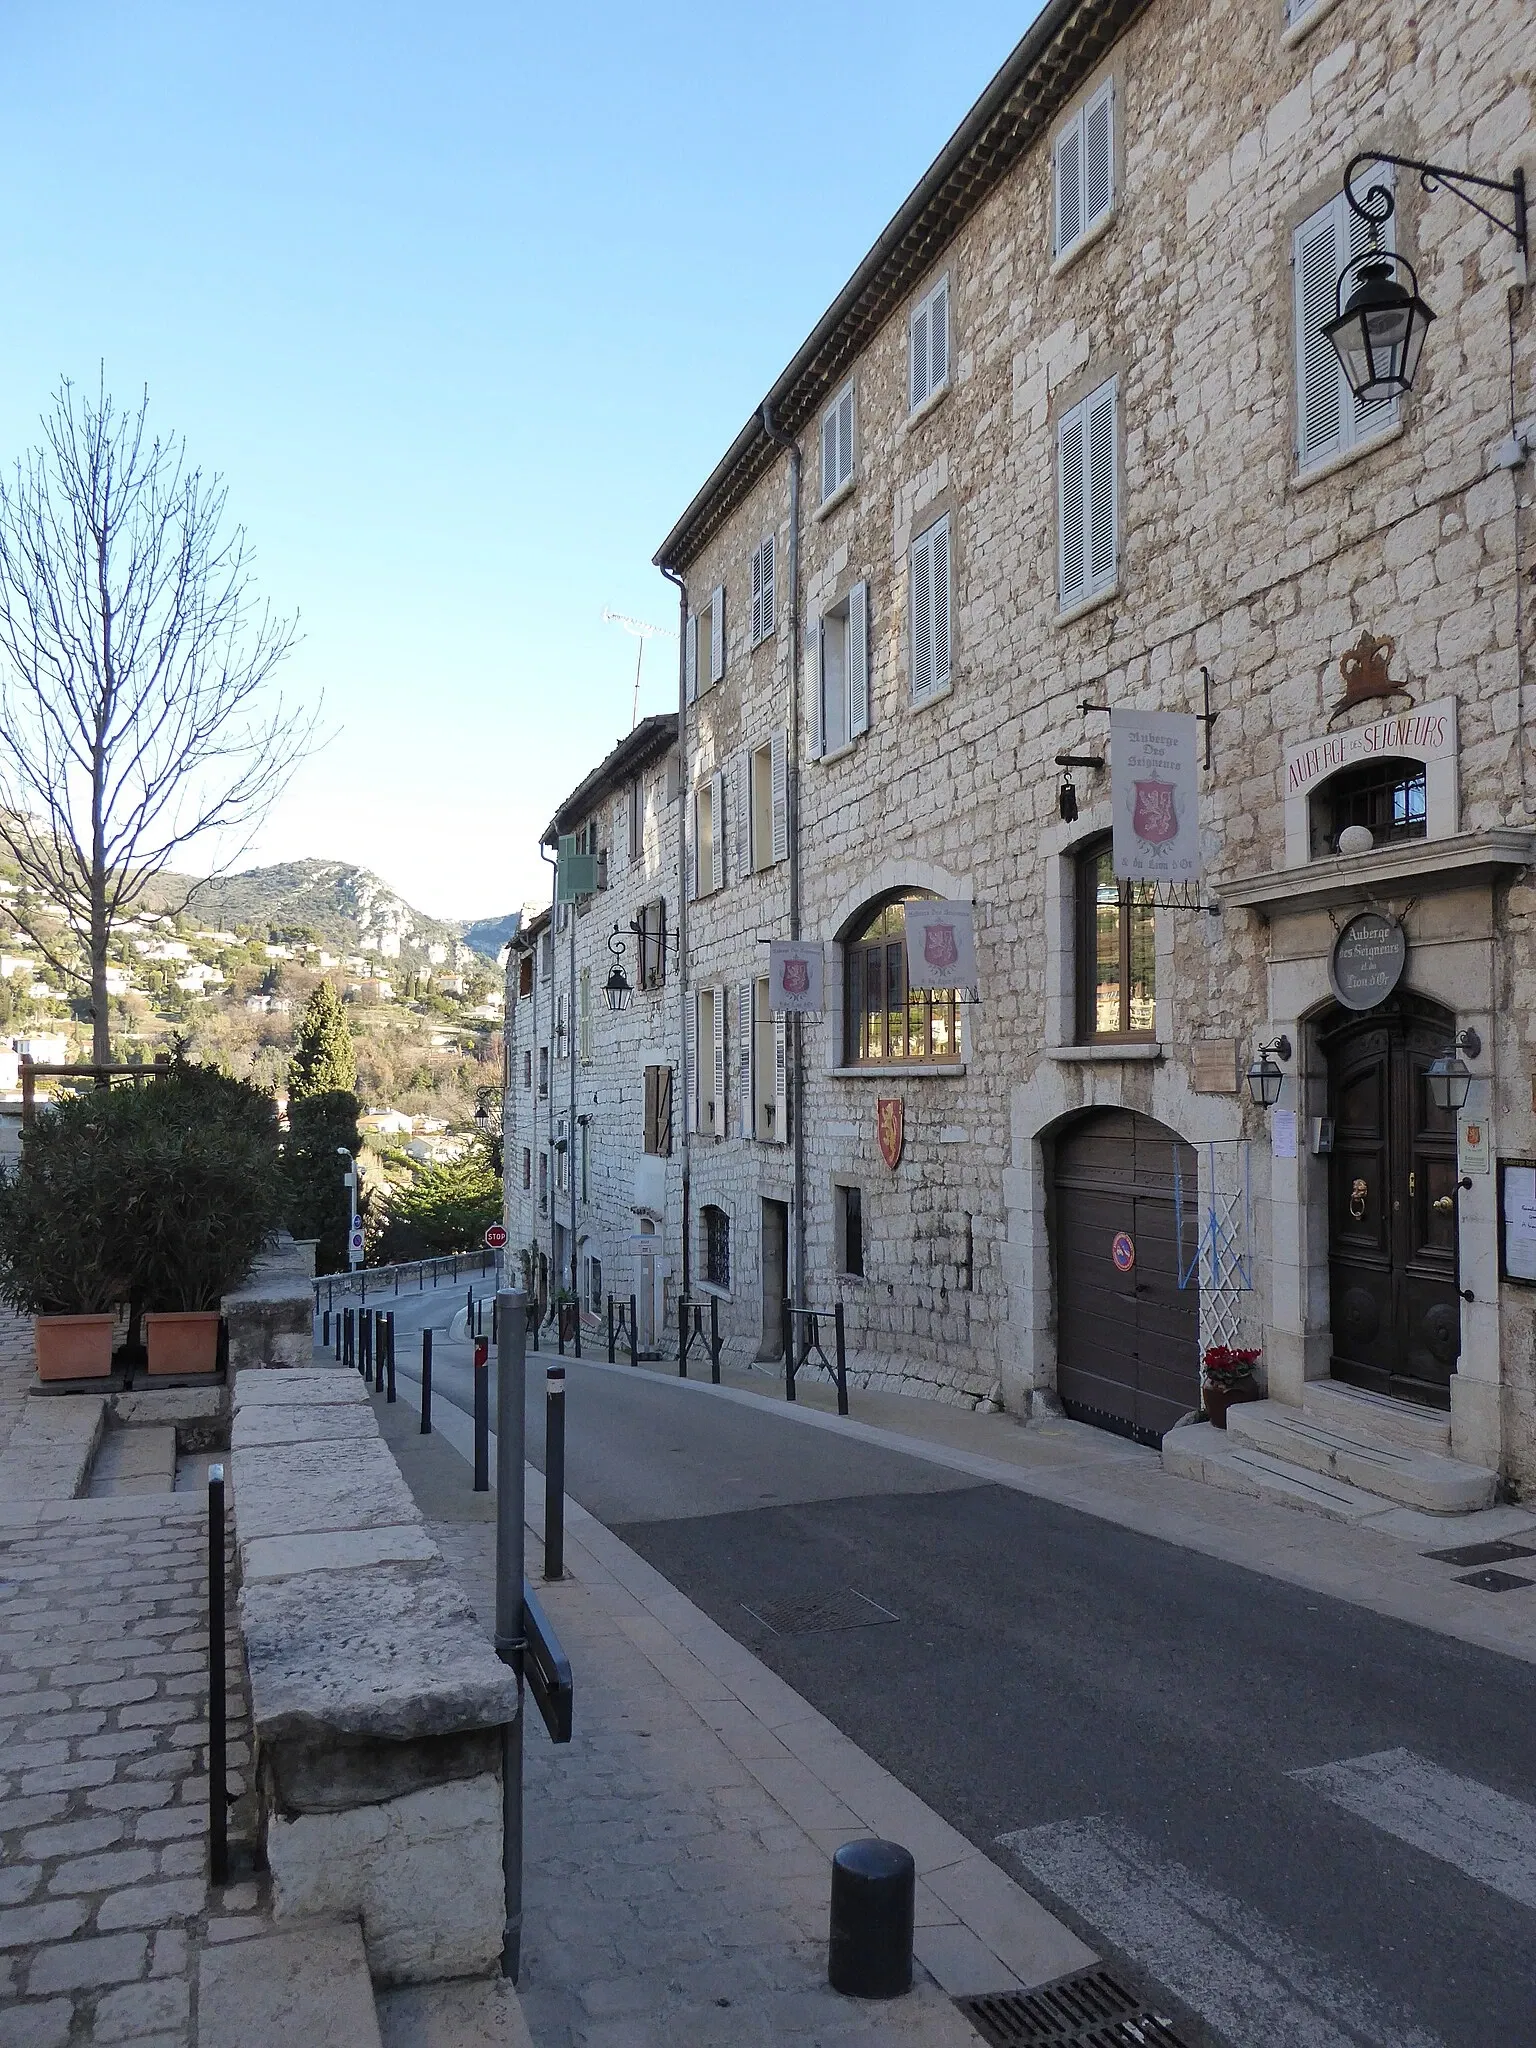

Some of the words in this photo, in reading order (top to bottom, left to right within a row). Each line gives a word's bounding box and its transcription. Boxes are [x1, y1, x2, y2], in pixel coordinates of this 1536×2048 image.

[1128, 731, 1180, 747] Auberge
[1143, 743, 1166, 757] Des
[1289, 736, 1348, 793] AUBERGE
[1363, 716, 1448, 753] SEIGNEURS
[1127, 755, 1182, 771] Seigneurs
[1348, 926, 1390, 943] Auberge
[1354, 943, 1400, 961] Seigneurs
[1344, 973, 1369, 989] Lion
[487, 1233, 506, 1241] STOP
